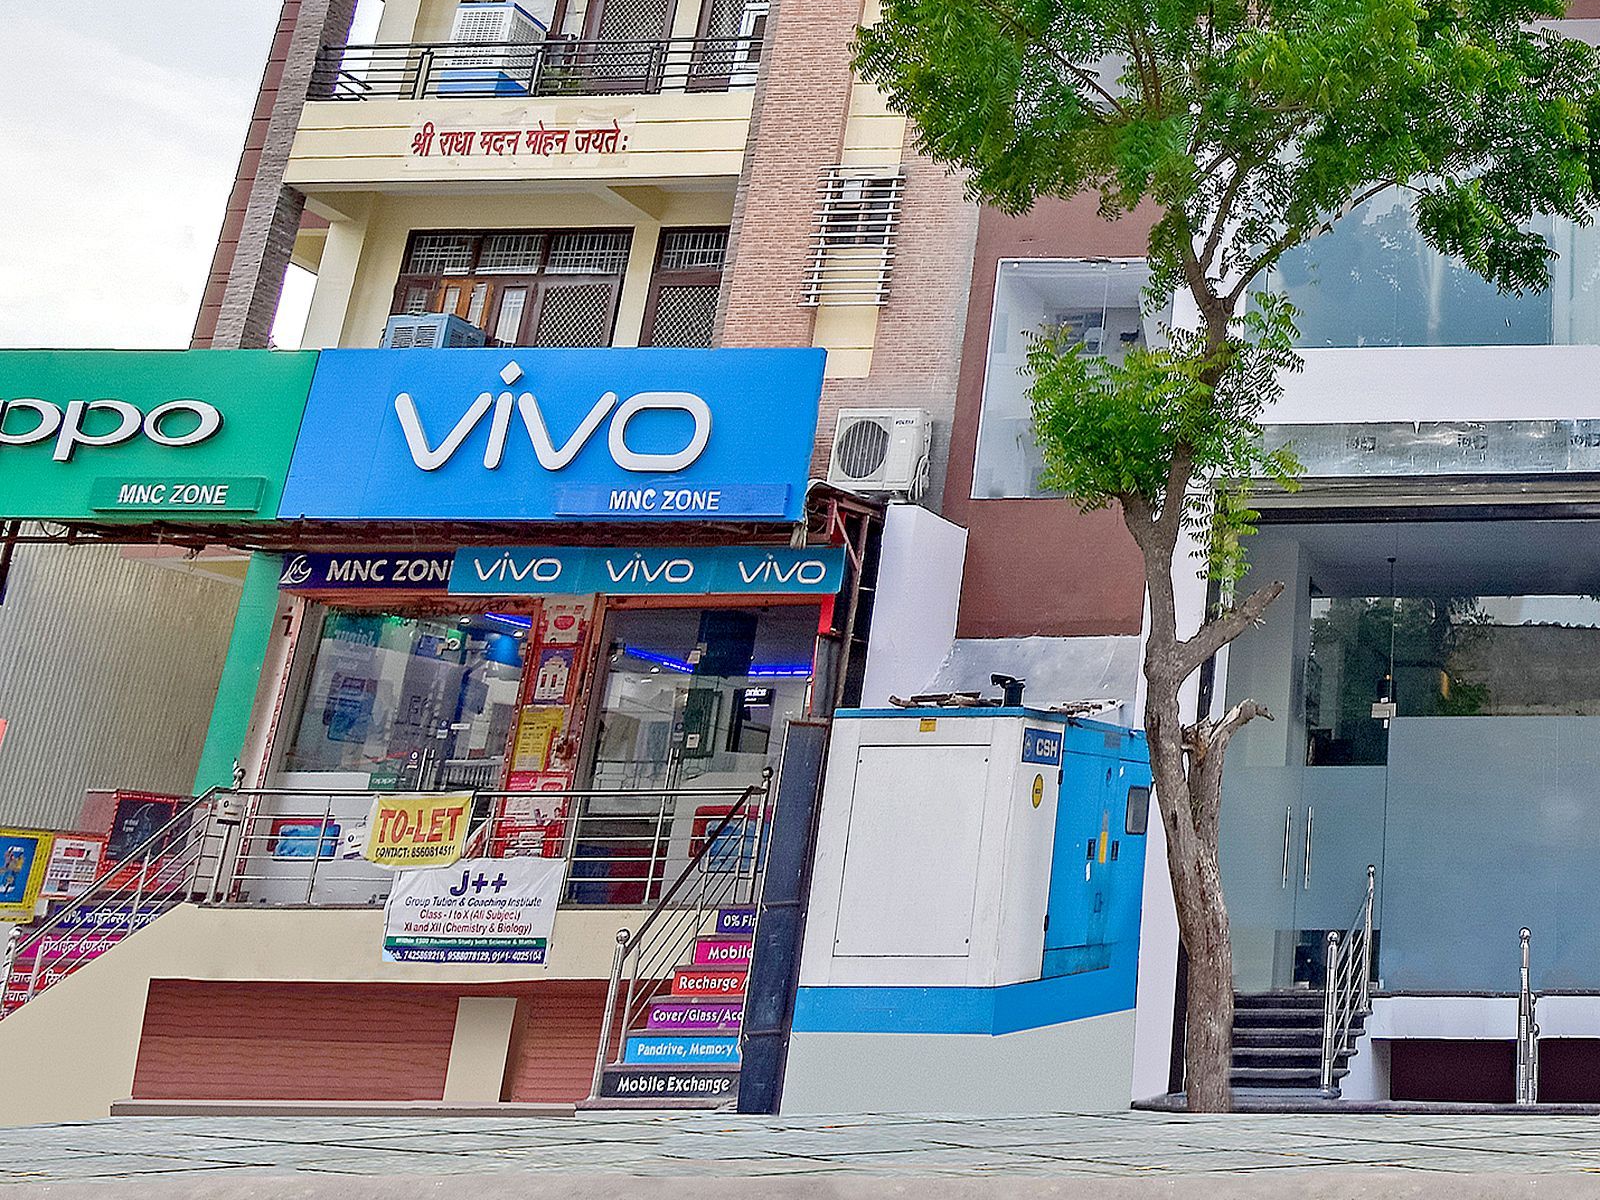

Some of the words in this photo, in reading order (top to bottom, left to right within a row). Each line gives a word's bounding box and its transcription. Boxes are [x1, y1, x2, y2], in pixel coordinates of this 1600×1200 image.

[411, 122, 435, 156] श्री
[440, 131, 476, 156] राधा
[479, 131, 521, 156] मदन
[526, 120, 570, 156] मोहन
[394, 360, 712, 472] vivo
[117, 484, 166, 504] MNC
[168, 484, 229, 505] ZONE
[609, 489, 656, 511] MNC
[660, 489, 721, 511] ZONE
[325, 559, 388, 582] MNC
[392, 559, 454, 582] ZON
[474, 551, 562, 582] vivo
[606, 552, 694, 583] vivo
[738, 553, 827, 584] vivo
[378, 807, 464, 844] TO-LET
[376, 846, 410, 858] CONTACT:
[450, 870, 508, 896] J++
[405, 896, 430, 908] Group
[459, 897, 465, 907] &
[467, 897, 506, 909] Coaching
[508, 897, 542, 907] Institute
[420, 909, 442, 919] Class
[453, 910, 462, 919] to
[463, 910, 470, 919] X
[470, 909, 484, 920] (All
[486, 909, 521, 921] Subject)
[723, 914, 740, 927] 0%
[404, 923, 413, 932] XI
[414, 923, 429, 932] and
[442, 923, 487, 934] (Chemistry
[488, 923, 495, 932] &
[497, 923, 532, 935] Biology)
[678, 975, 738, 991] Recharge
[637, 1042, 687, 1058] Pandrive,
[689, 1042, 734, 1057] Memory
[616, 1077, 666, 1093] Mobile
[667, 1076, 731, 1094] Exchange
